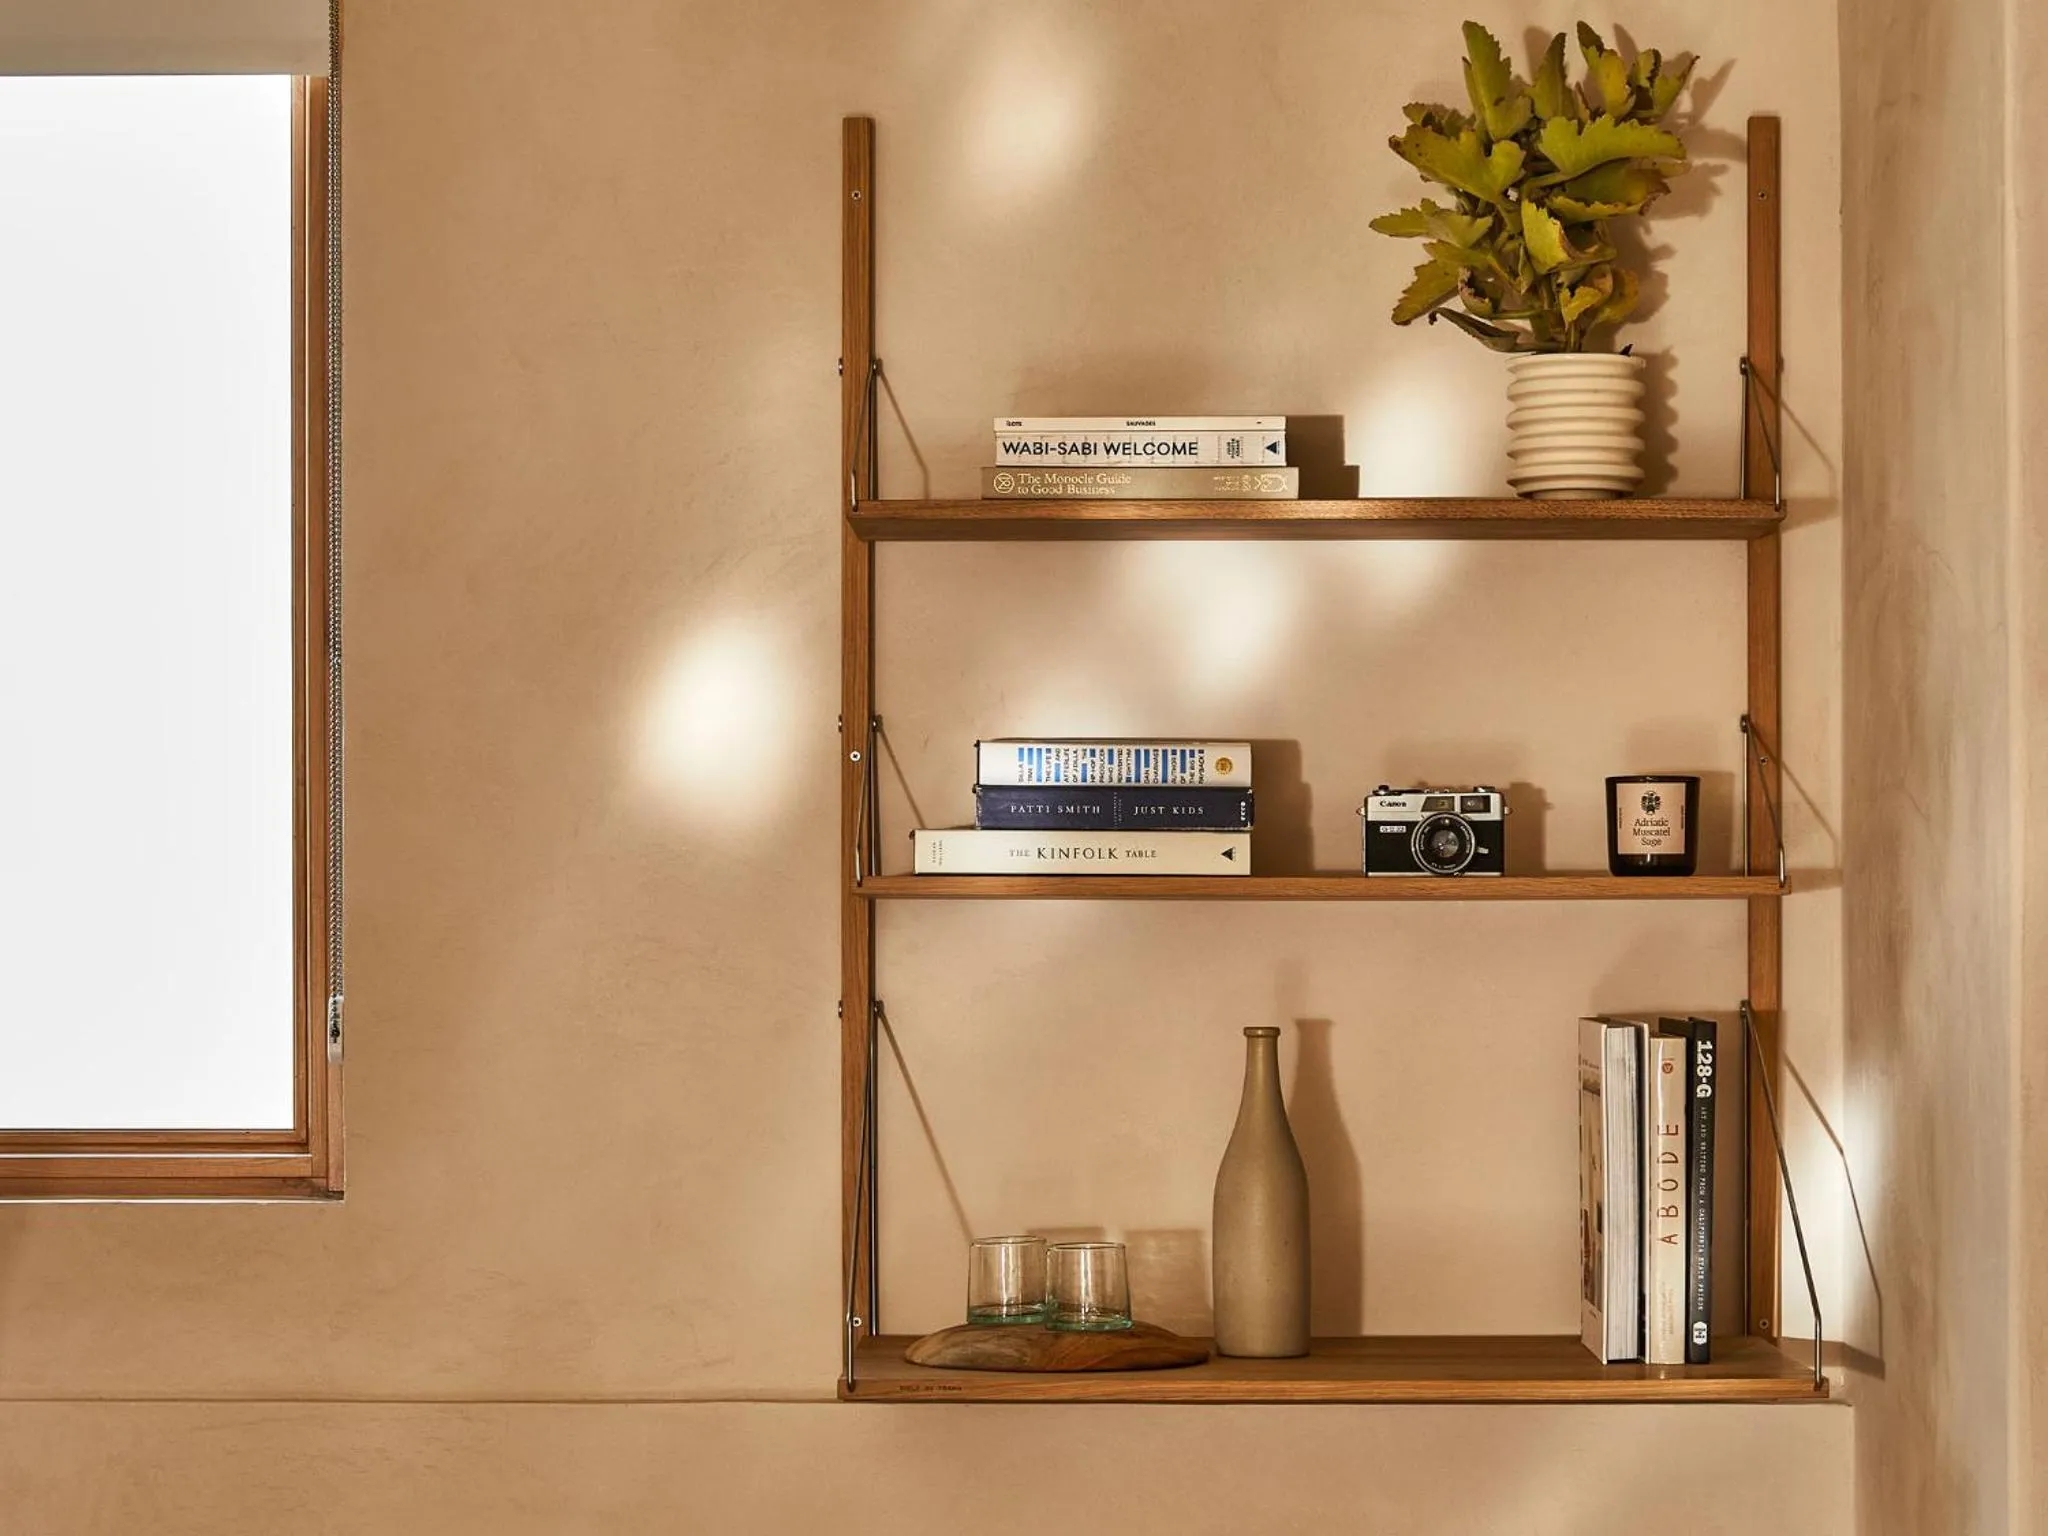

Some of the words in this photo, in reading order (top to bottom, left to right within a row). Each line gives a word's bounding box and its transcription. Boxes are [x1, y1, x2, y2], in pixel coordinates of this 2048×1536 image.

[1002, 442, 1097, 455] WABI-SABI
[1103, 442, 1198, 455] WELCOME
[1017, 473, 1041, 484] The
[1045, 473, 1093, 484] Monocle
[1097, 473, 1132, 484] Guide
[1017, 485, 1029, 494] to
[1031, 485, 1062, 494] Good
[1067, 485, 1116, 494] Business
[1010, 805, 1050, 813] PATTI
[1057, 805, 1100, 814] SMITH
[1133, 806, 1165, 816] JUST
[1173, 806, 1204, 815] KIDS
[1634, 817, 1669, 826] Adriatic
[1641, 838, 1662, 847] Sage
[1009, 849, 1030, 857] THE
[1037, 847, 1118, 859] KINFOLK
[1125, 850, 1156, 858] TABLE
[1696, 1040, 1713, 1098] 128-G
[1657, 1123, 1679, 1246] ABODE
